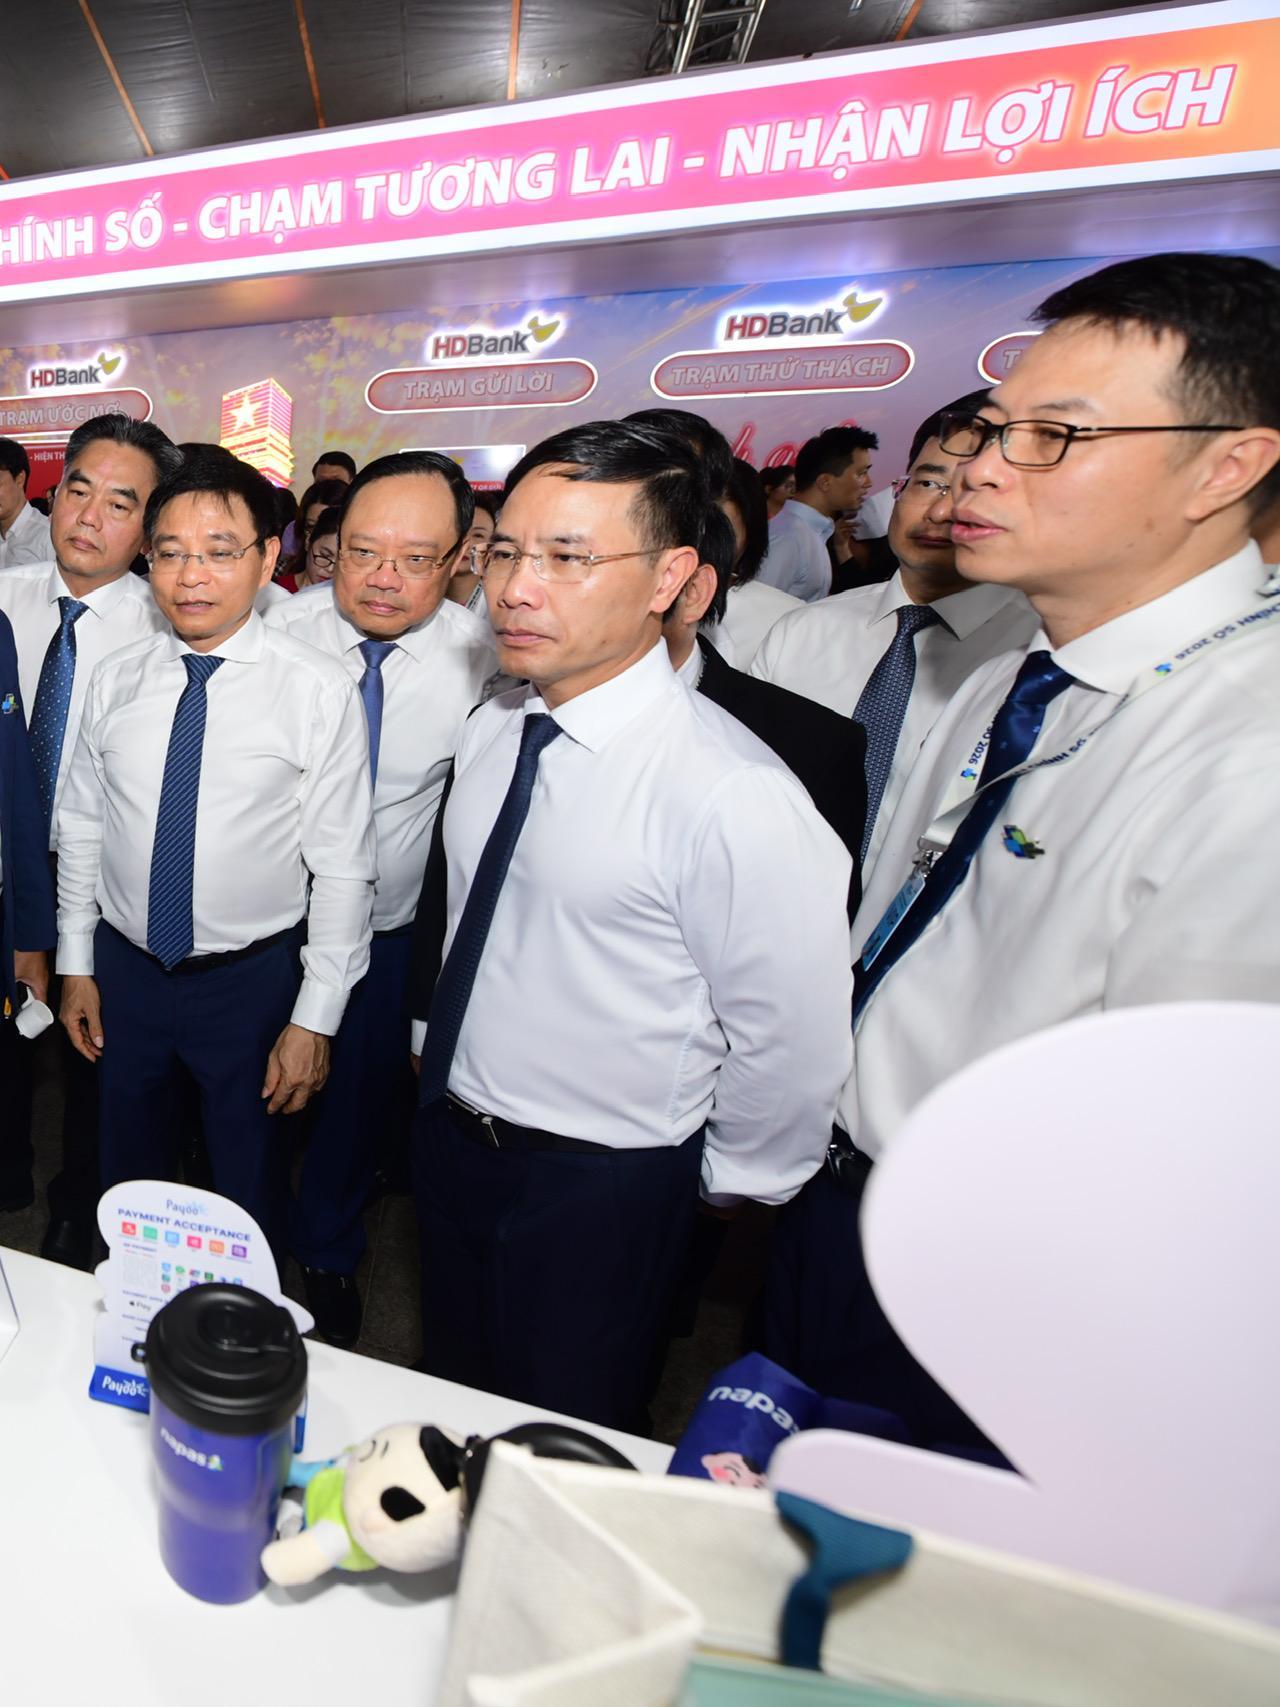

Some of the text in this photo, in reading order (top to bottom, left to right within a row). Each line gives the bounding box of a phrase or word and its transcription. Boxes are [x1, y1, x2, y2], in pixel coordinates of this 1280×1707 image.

[105, 191, 163, 252] SỐ
[198, 179, 342, 244] CHẠM
[354, 150, 557, 222] TƯƠNG
[569, 136, 671, 196] LAI
[719, 104, 930, 180] NHẬN
[942, 80, 1074, 164] LỢI
[1083, 63, 1237, 139] ÍCH
[724, 309, 845, 341] HDBank
[431, 330, 533, 361] HDBank
[30, 365, 102, 389] HDBank
[404, 379, 466, 403] TRẠM
[516, 370, 554, 393] LỜI
[671, 355, 891, 389] TRẠM THỬ THÁCH
[48, 404, 88, 423] ƯỚC
[968, 740, 988, 765] 2026
[166, 1199, 199, 1216] Payoo
[117, 1208, 251, 1242] PAYMENT ACCEPTANCE
[102, 1375, 138, 1397] Payoo
[160, 1427, 207, 1467] napas
